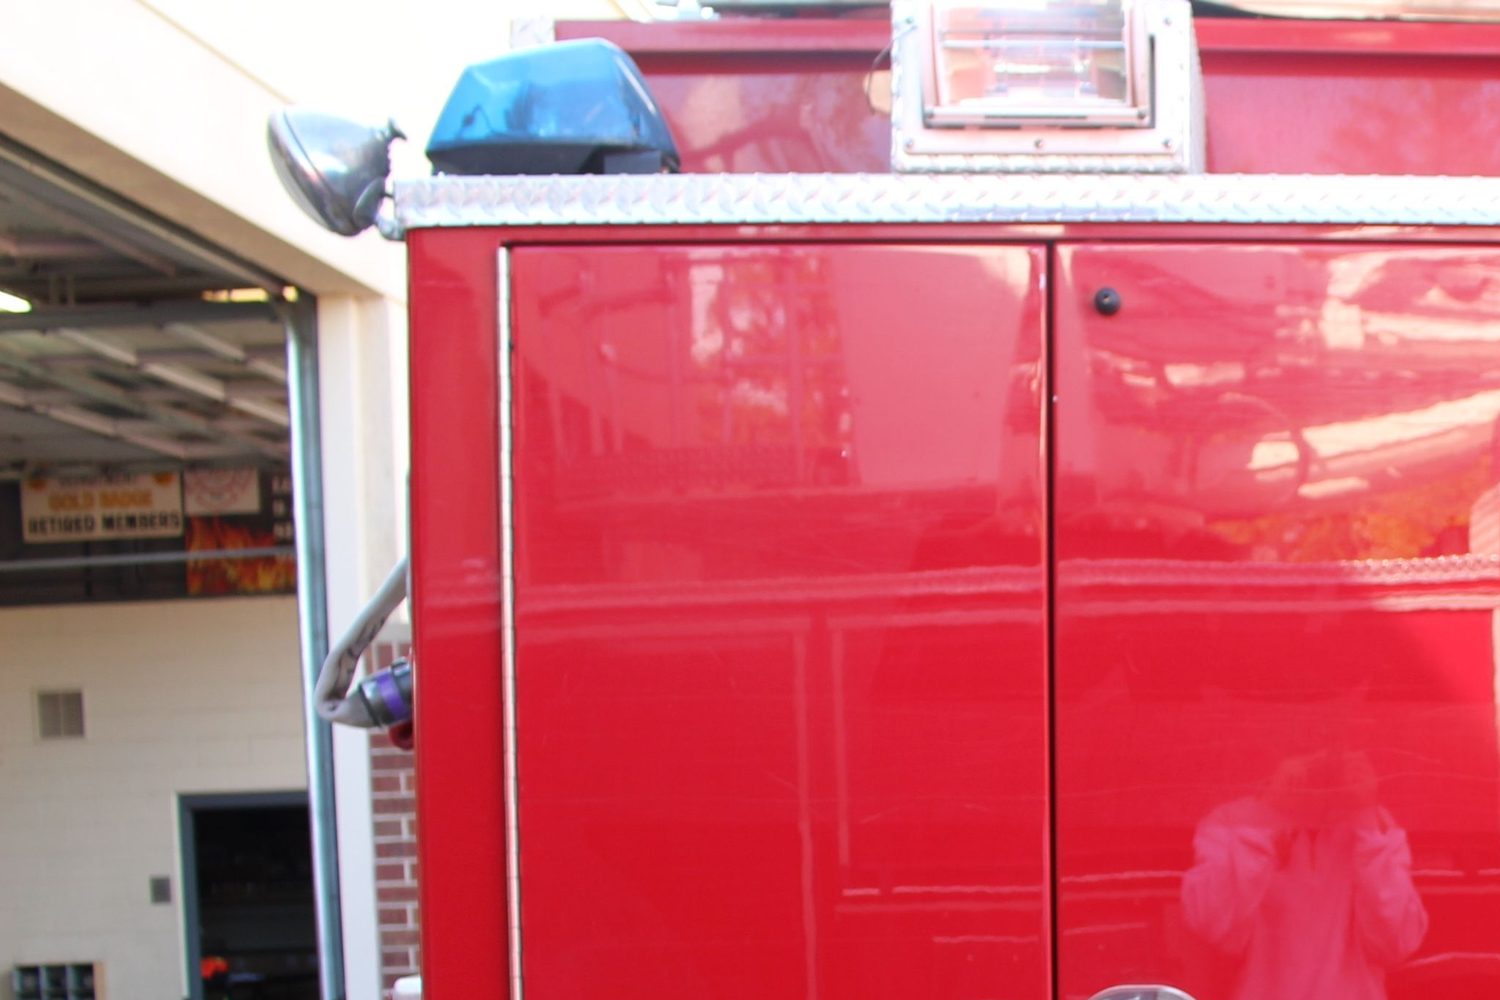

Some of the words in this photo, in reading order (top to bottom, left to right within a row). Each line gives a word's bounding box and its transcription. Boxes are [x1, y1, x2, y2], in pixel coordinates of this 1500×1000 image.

[47, 492, 95, 511] GOLD
[98, 489, 152, 507] BADGE
[28, 513, 95, 535] RETIRED
[101, 511, 180, 531] MEMBERS
